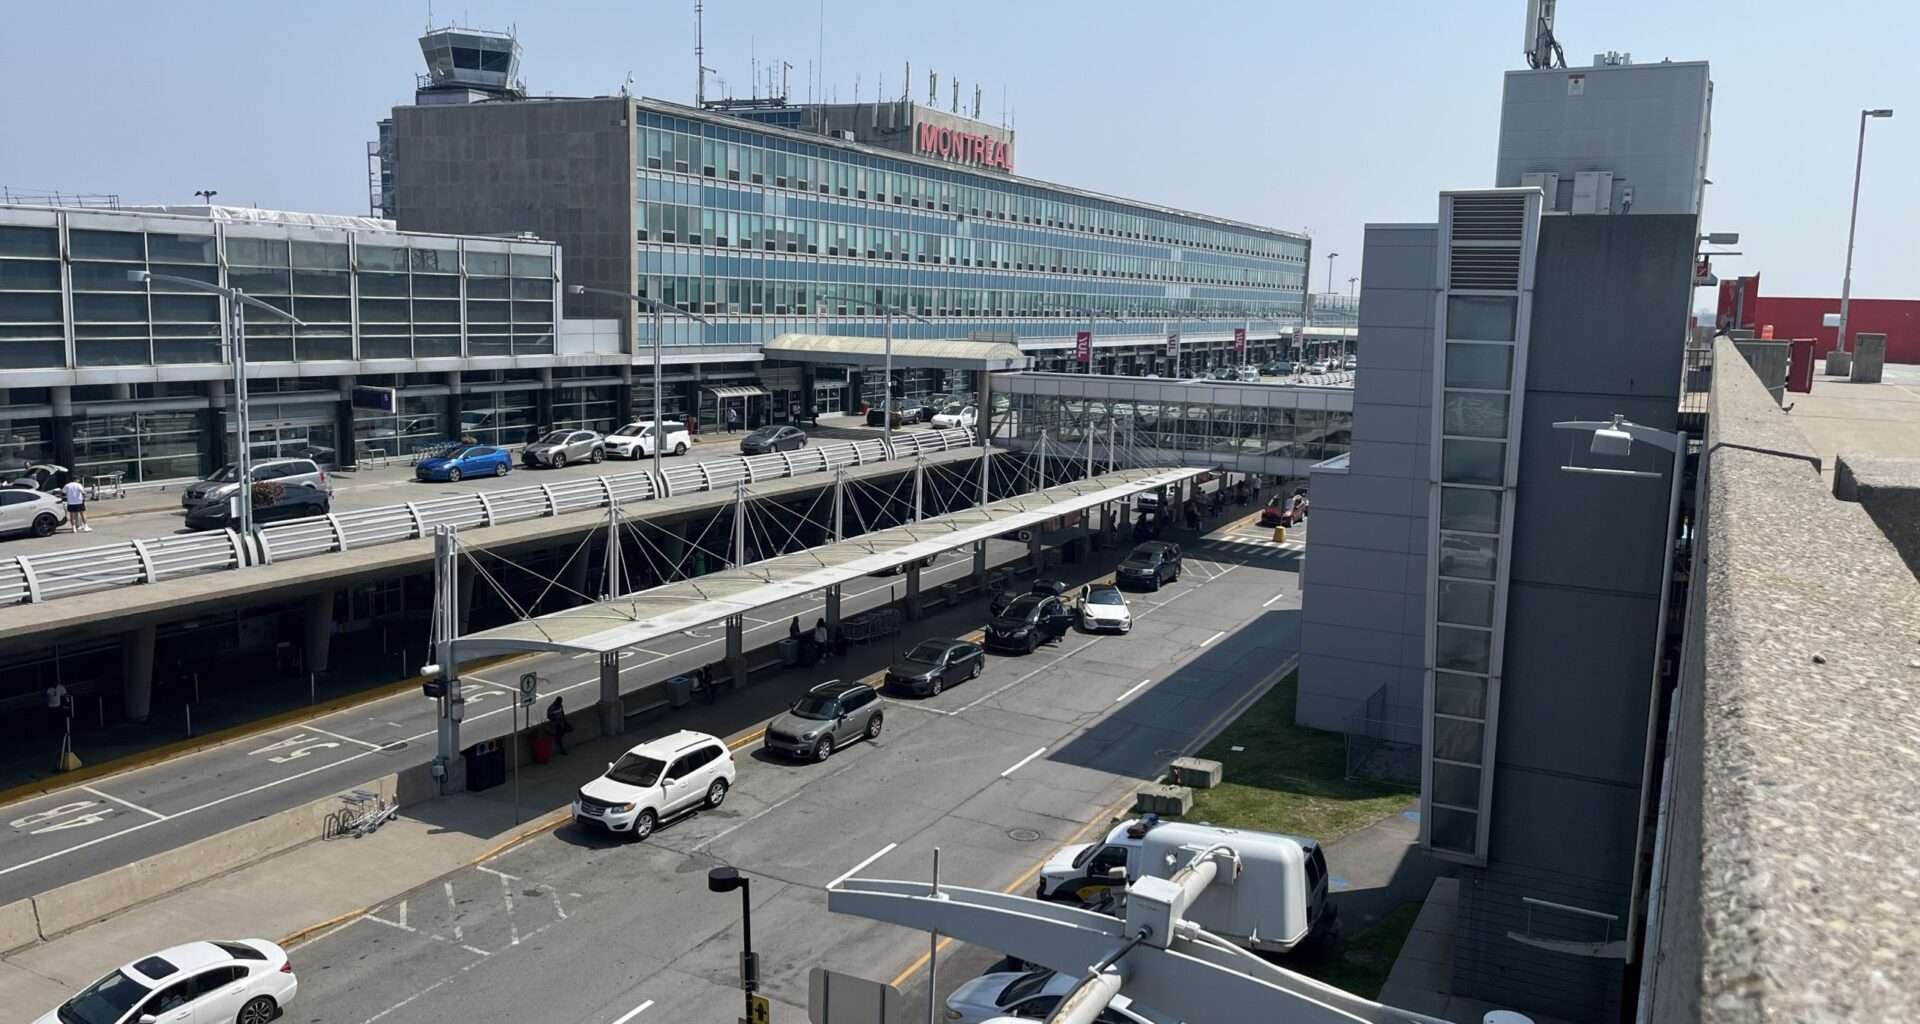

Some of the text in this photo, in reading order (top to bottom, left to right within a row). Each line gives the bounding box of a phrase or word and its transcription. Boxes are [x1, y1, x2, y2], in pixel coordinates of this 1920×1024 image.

[920, 121, 1013, 169] MONTRÉAL
[1078, 336, 1088, 358] YUL
[1168, 334, 1176, 352] YUL
[1235, 332, 1243, 348] YUL
[1021, 531, 1030, 540] D
[248, 733, 340, 763] 5A
[9, 800, 114, 834] 4B
